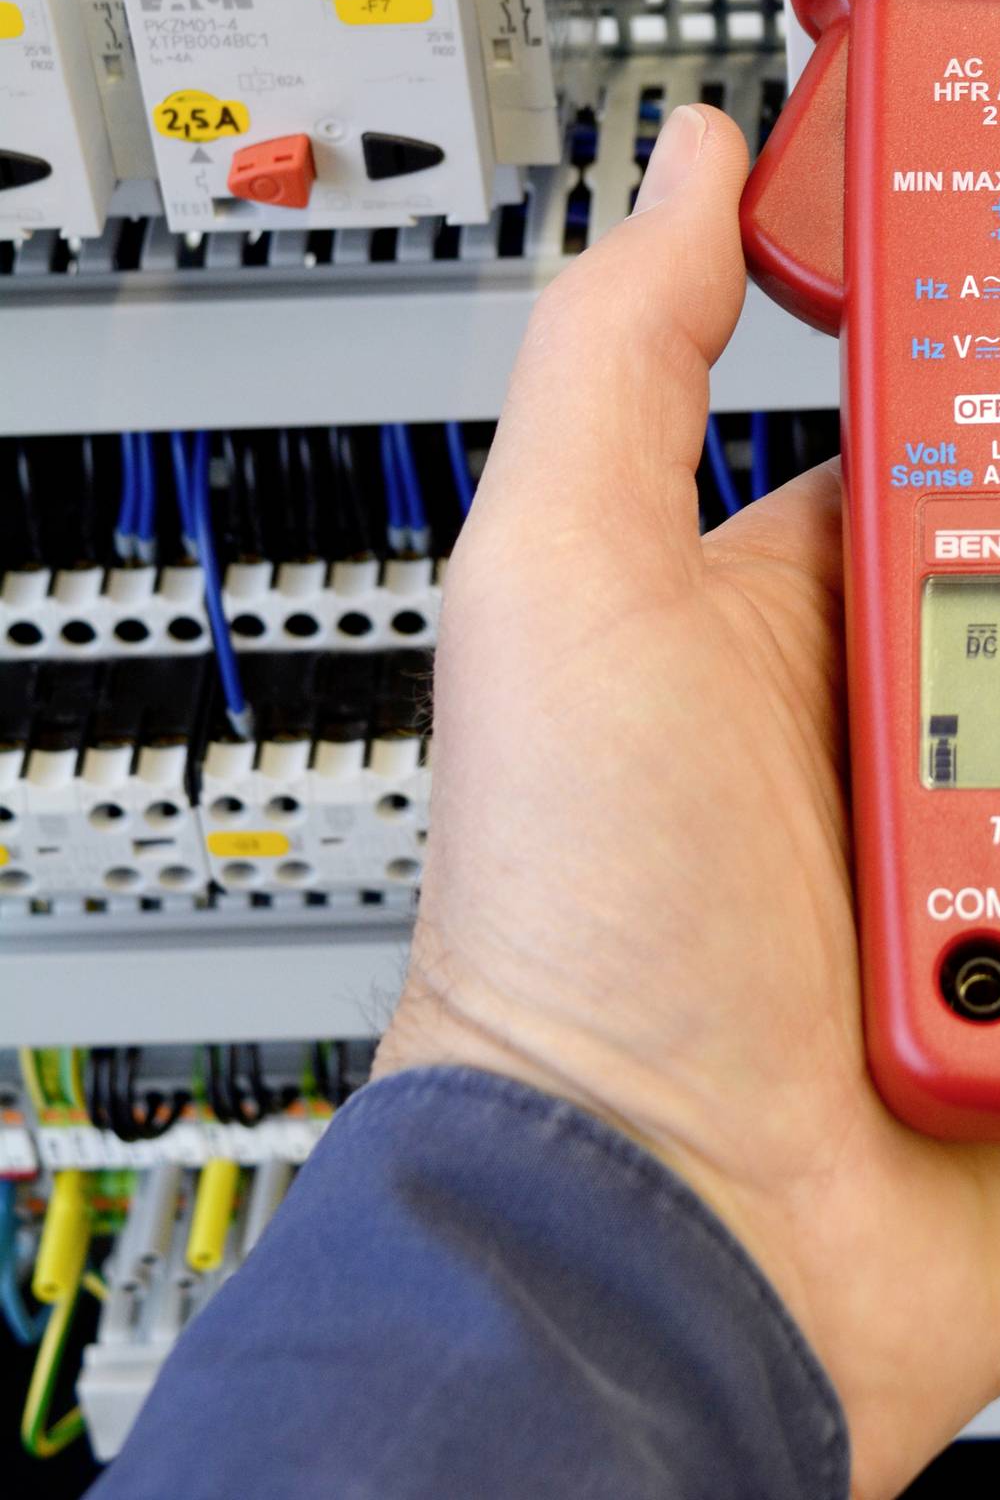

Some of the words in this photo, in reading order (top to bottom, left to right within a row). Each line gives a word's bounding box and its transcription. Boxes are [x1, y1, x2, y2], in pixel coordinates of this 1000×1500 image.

[944, 58, 983, 78] AC
[934, 81, 991, 101] HFR
[982, 106, 998, 125] 2
[893, 171, 944, 192] MIN
[915, 278, 949, 300] Hz
[911, 337, 945, 359] Hz
[905, 442, 957, 464] Volt
[891, 465, 974, 487] Sense
[966, 636, 998, 659] DC
